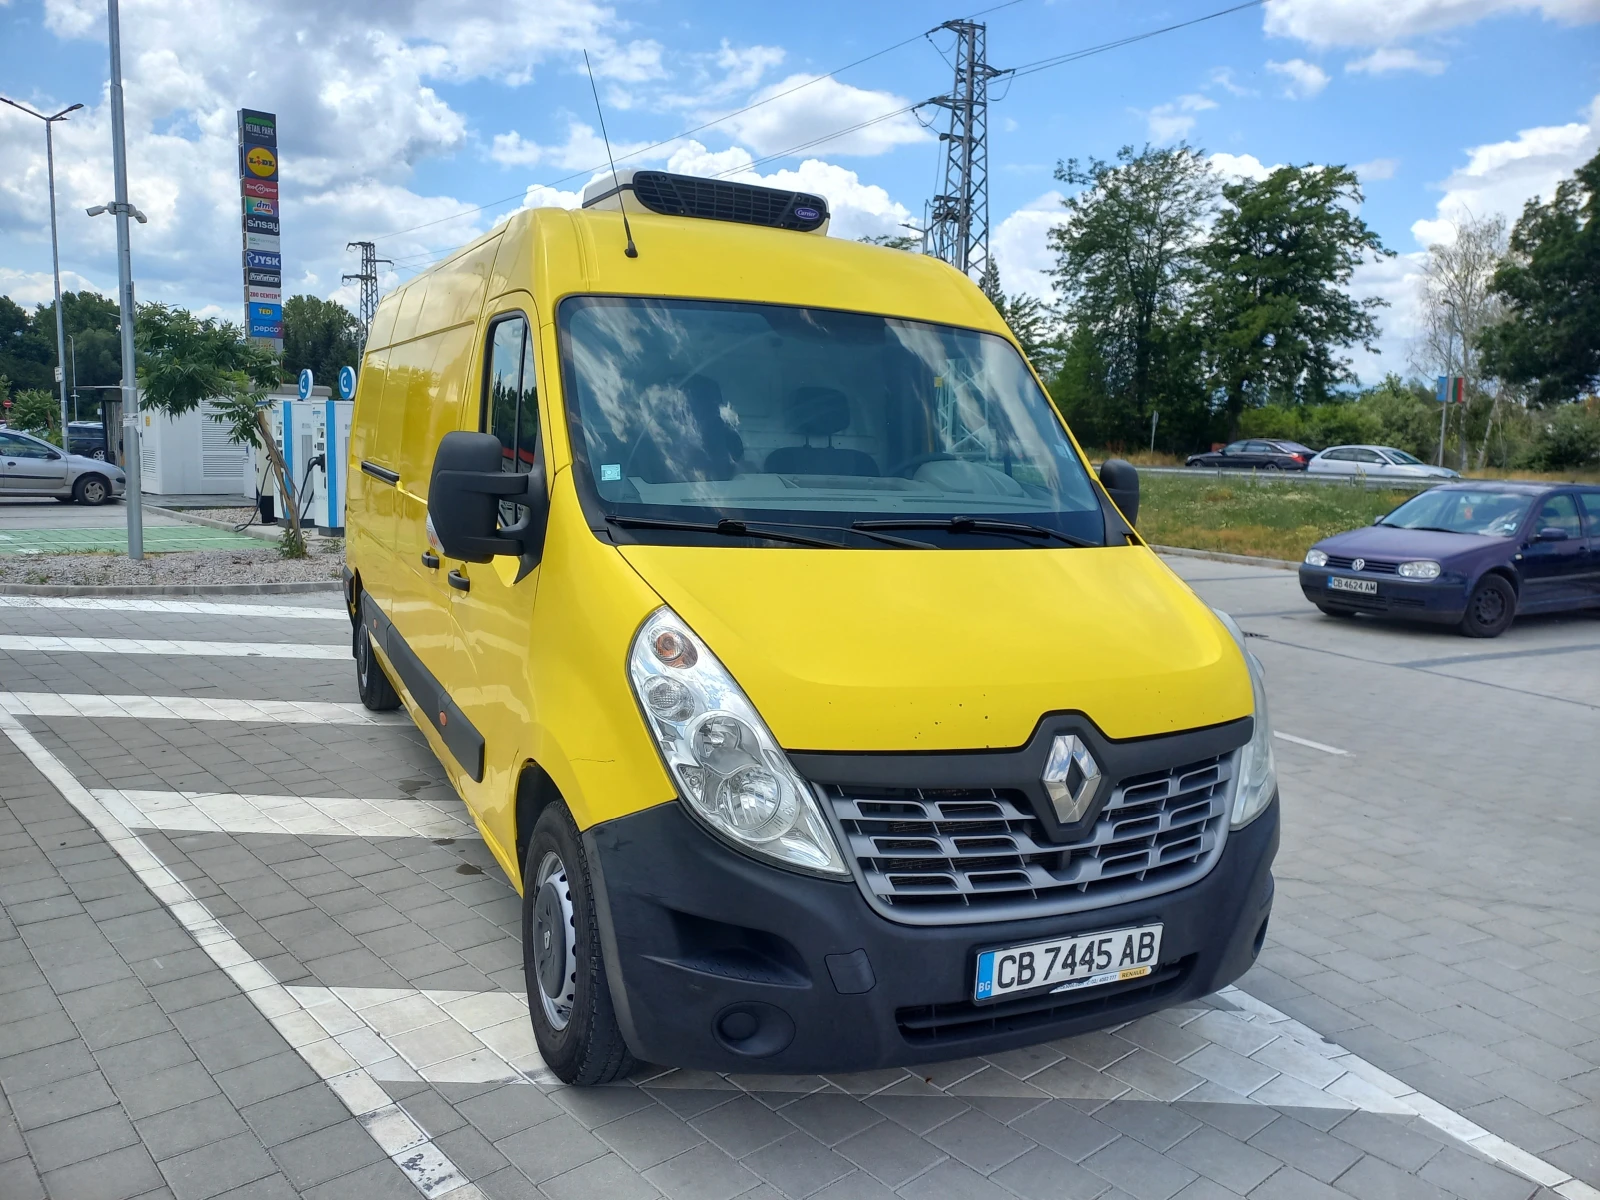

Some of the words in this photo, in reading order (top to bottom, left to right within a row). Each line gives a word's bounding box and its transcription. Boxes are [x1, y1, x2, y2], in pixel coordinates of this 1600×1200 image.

[245, 123, 261, 134] RETAIL
[261, 126, 274, 136] PARK
[248, 156, 274, 167] LIDL
[256, 200, 271, 210] dm
[797, 209, 817, 218] Carrier
[253, 255, 280, 266] JYSK
[253, 325, 279, 333] pepco
[1333, 578, 1343, 588] CB
[1344, 580, 1363, 590] 4624
[1364, 582, 1376, 592] AM
[997, 951, 1036, 989] CB
[1042, 938, 1113, 982] 7445
[1118, 931, 1155, 967] AB
[1121, 968, 1147, 979] RENAULT
[978, 982, 991, 992] BG
